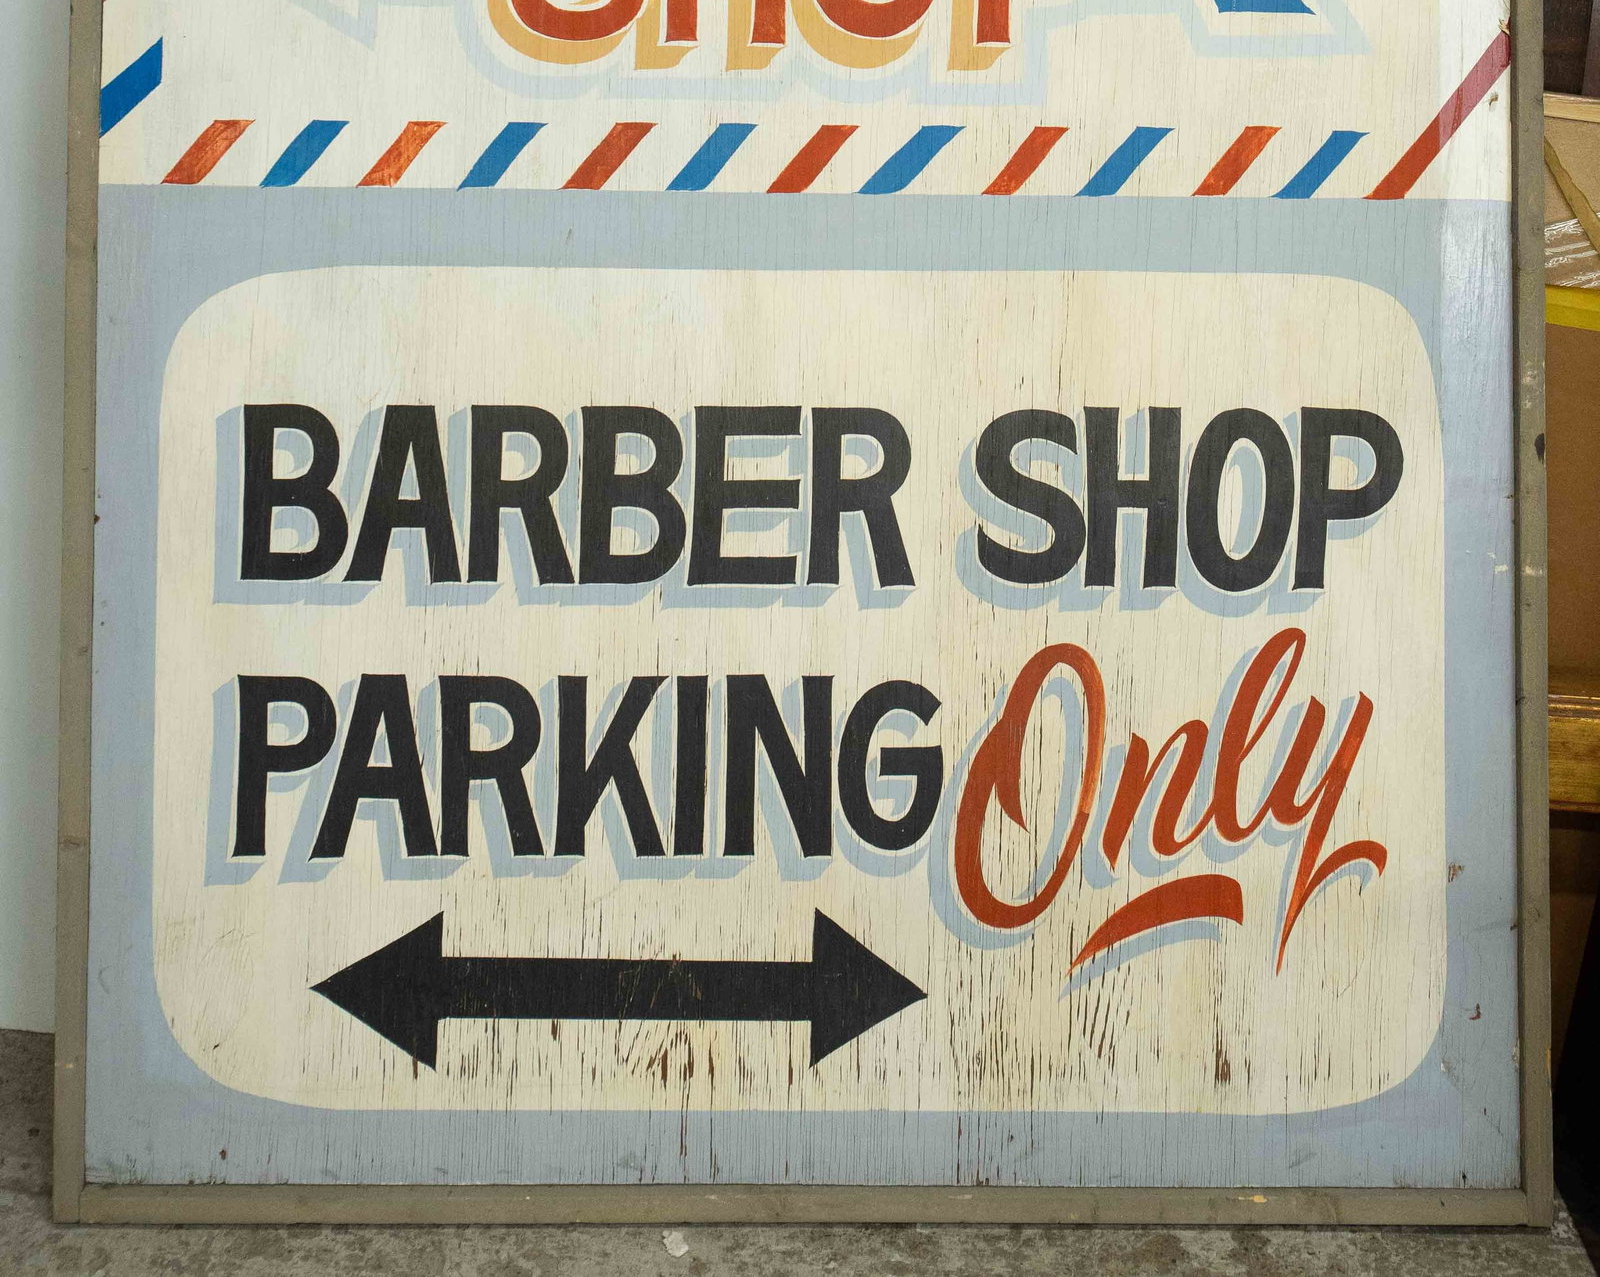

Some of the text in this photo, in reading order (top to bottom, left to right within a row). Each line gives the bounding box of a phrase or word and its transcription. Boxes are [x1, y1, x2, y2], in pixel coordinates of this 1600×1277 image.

[240, 403, 1404, 592] BARBER SHOP
[231, 626, 1388, 977] PARKING Only
